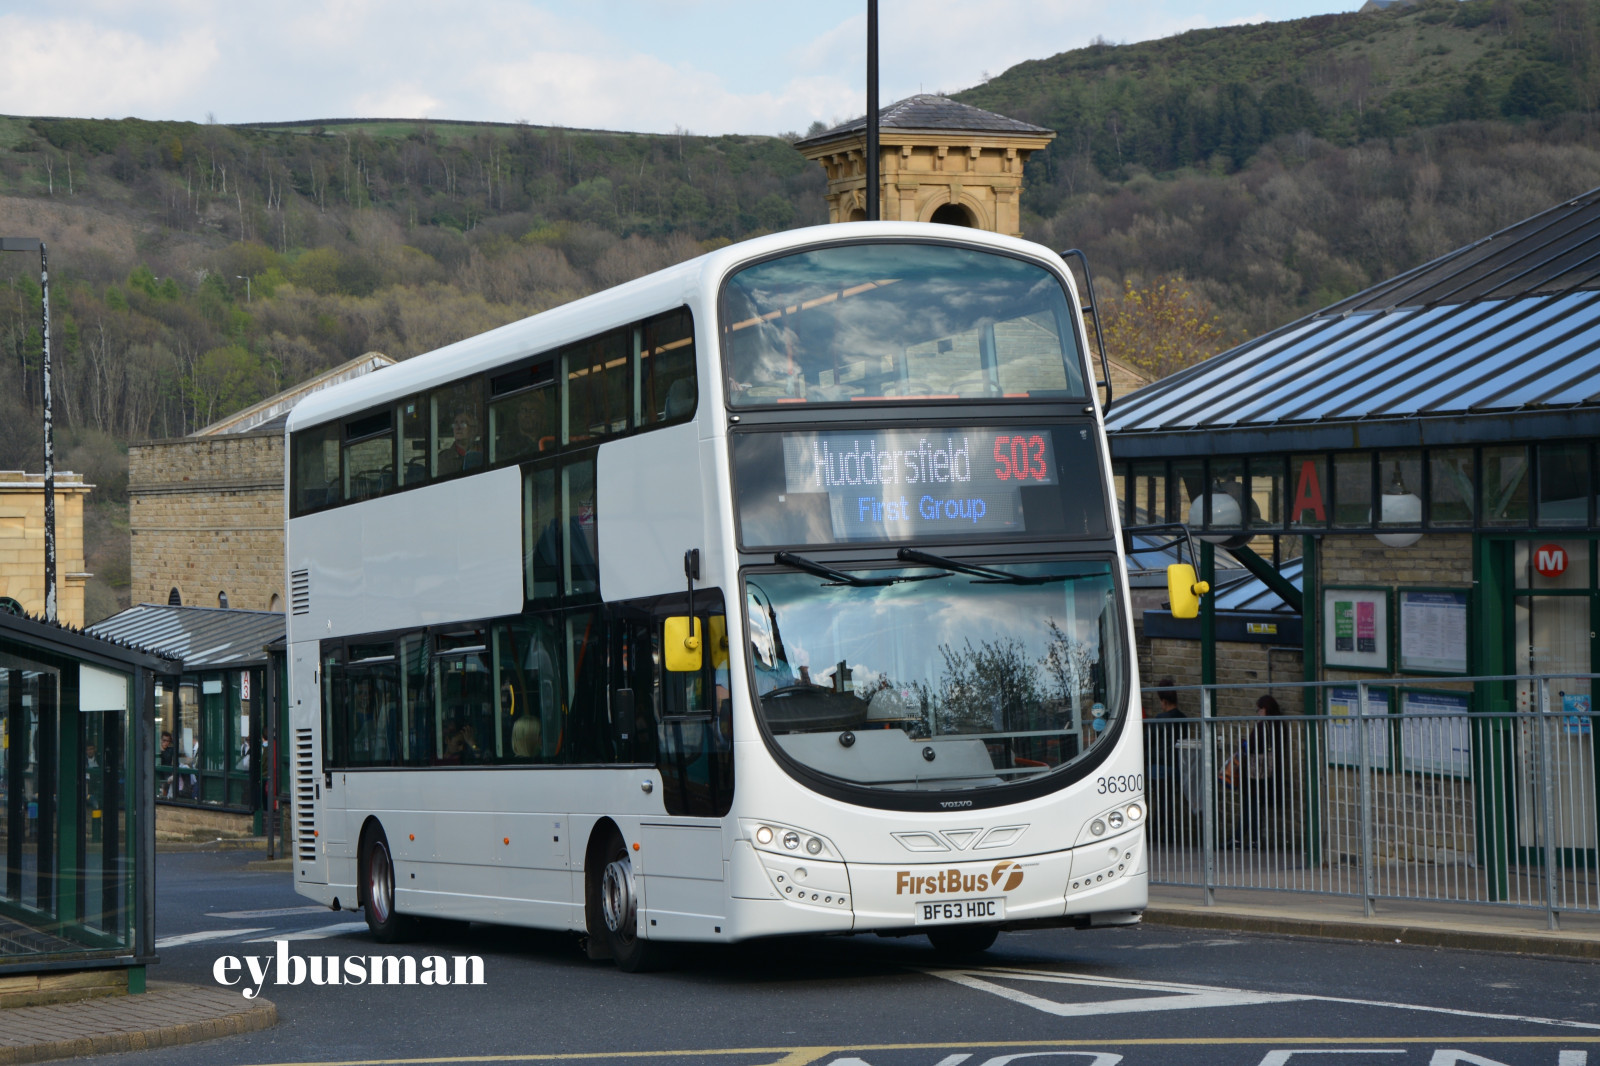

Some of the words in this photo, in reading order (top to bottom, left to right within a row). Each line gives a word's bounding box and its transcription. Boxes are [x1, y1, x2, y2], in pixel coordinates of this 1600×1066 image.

[813, 436, 971, 487] Huddersfield
[993, 434, 1048, 482] 503
[1291, 460, 1327, 523] A
[858, 495, 910, 523] First
[918, 495, 987, 523] Group
[1538, 550, 1564, 571] M
[1097, 774, 1143, 795] 36300
[940, 800, 973, 808] VOLVO
[896, 868, 989, 895] FirstBus
[923, 902, 963, 920] BF63
[966, 901, 996, 918] HDC
